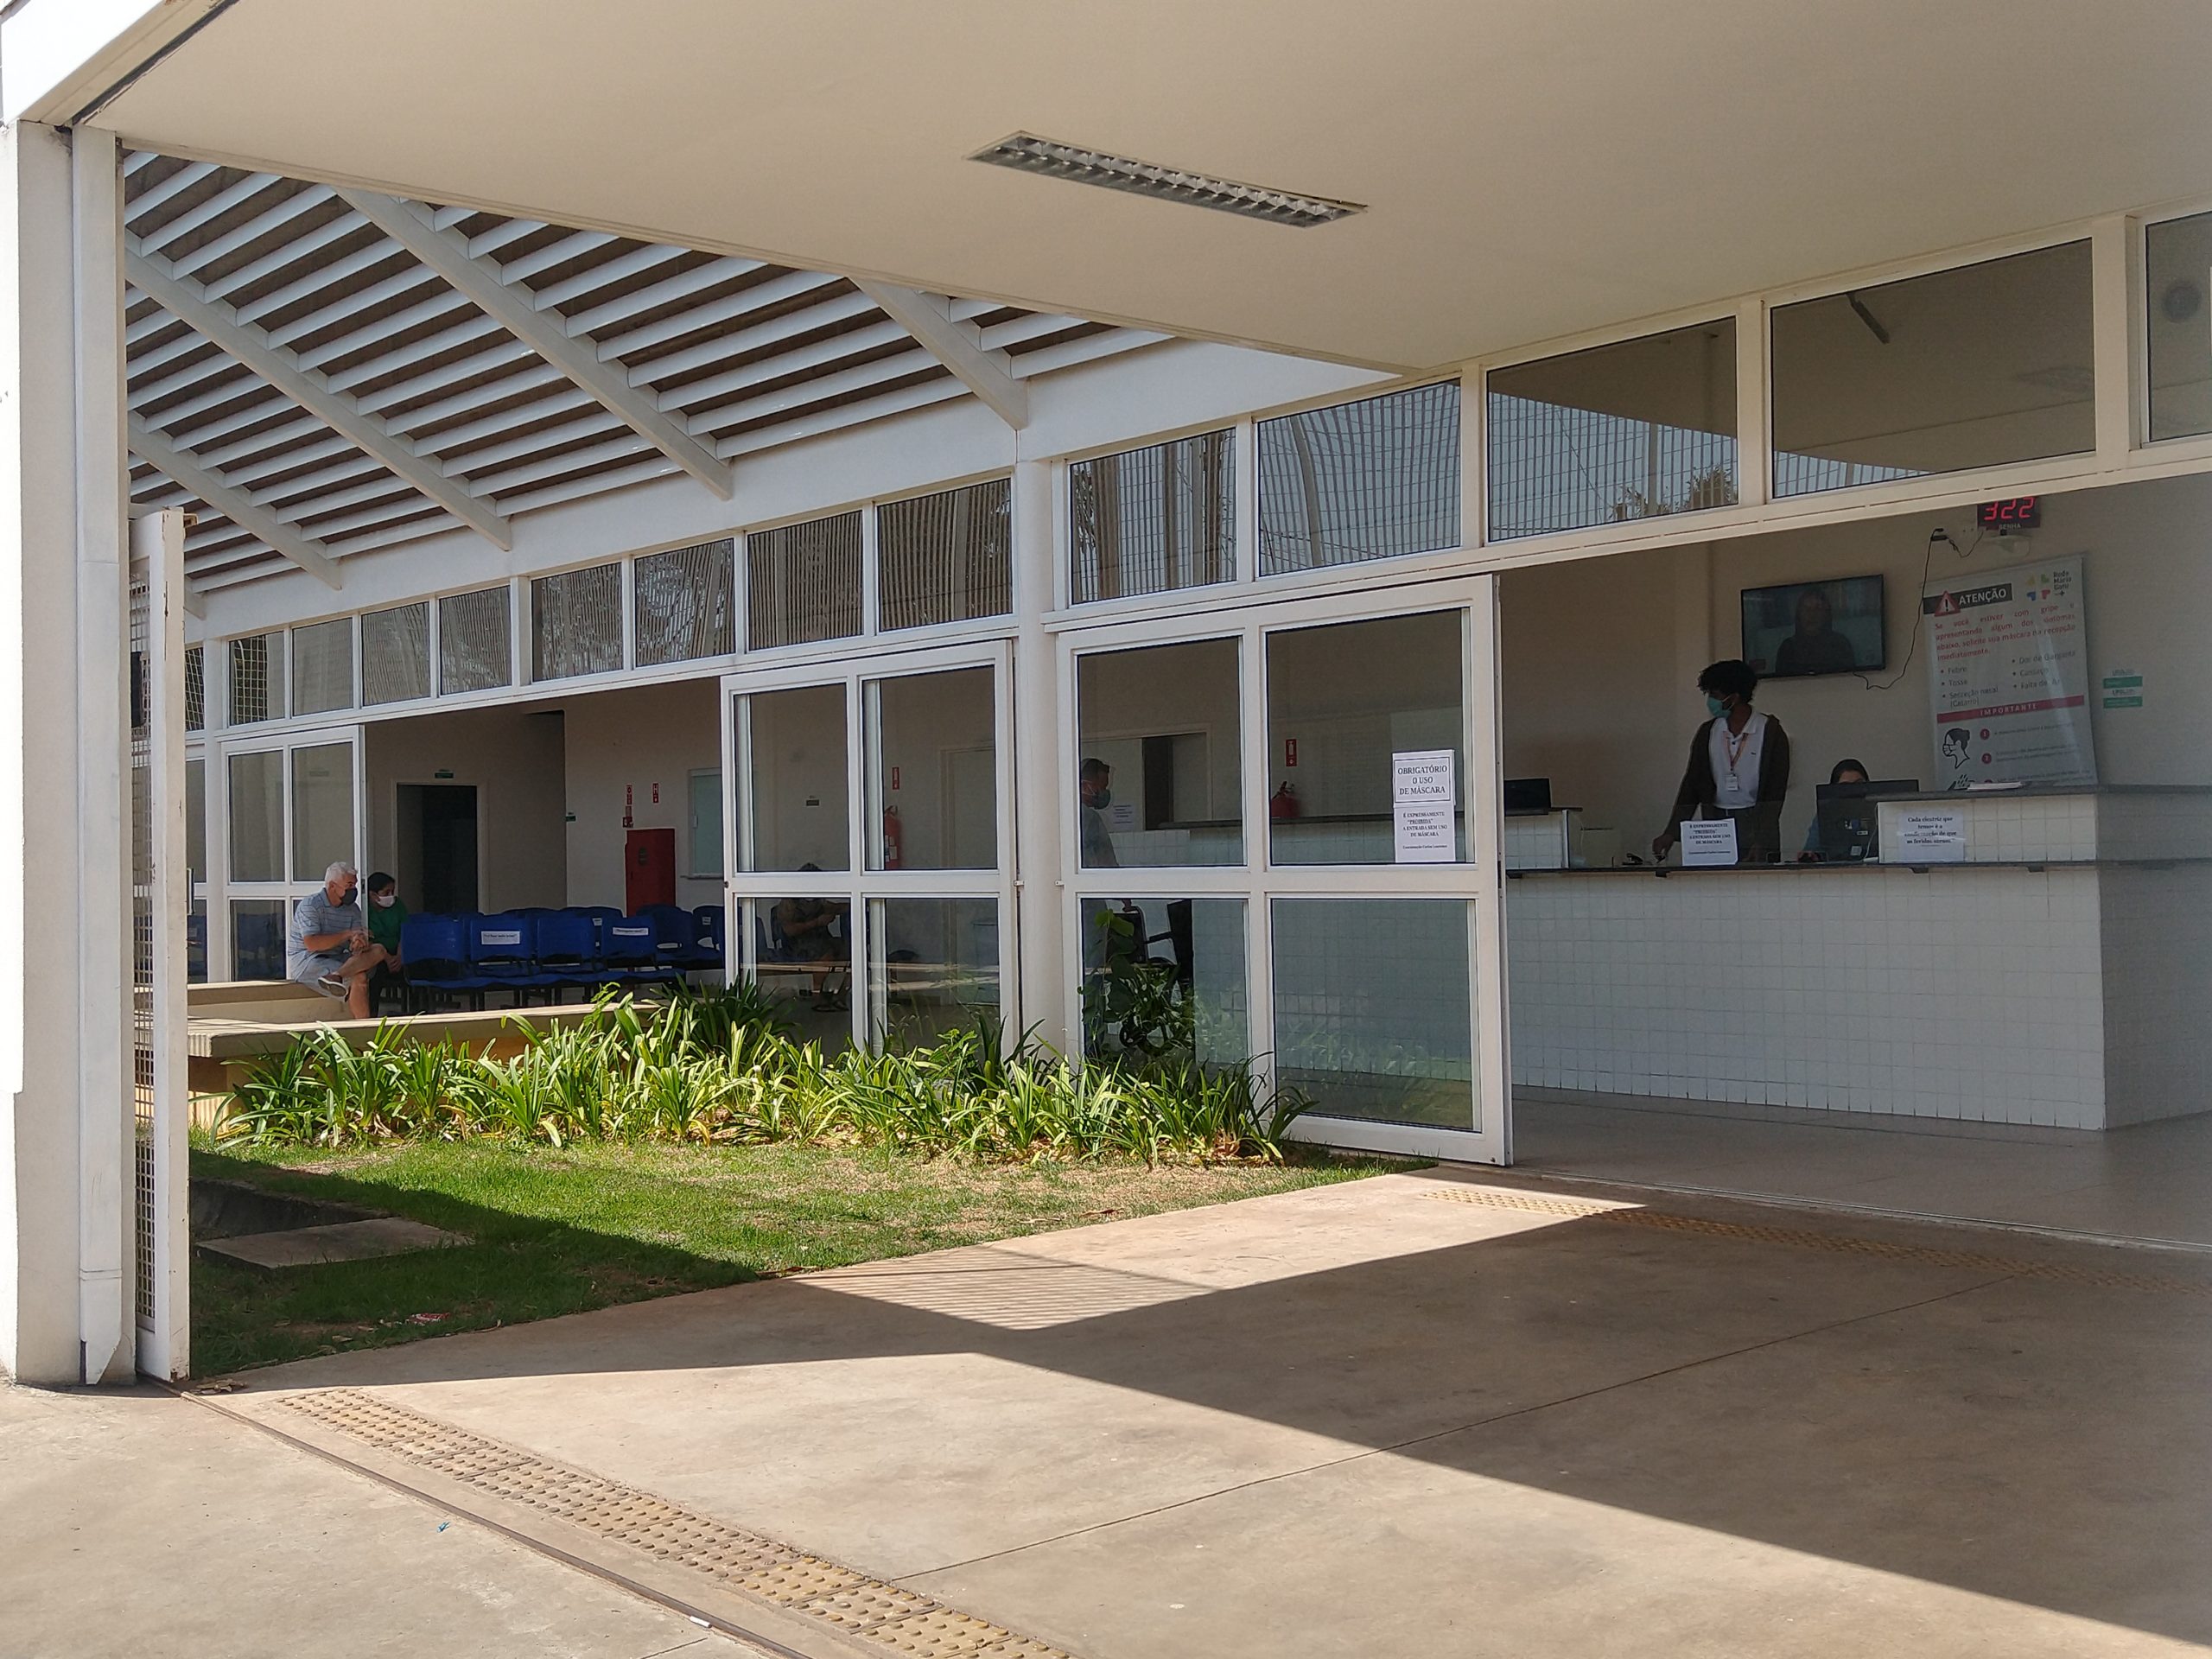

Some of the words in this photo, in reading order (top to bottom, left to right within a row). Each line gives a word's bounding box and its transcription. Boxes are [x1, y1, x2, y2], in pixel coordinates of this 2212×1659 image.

[1984, 495, 2035, 520] 322
[1959, 588, 2007, 606] ATENÇÃO
[1980, 613, 2004, 623] estiver
[2040, 605, 2059, 614] gripe
[1936, 627, 1983, 641] apresentando
[1980, 704, 2038, 716] IMPORTANTE
[1397, 765, 1447, 775] OBRIGATÓRIO
[1410, 785, 1446, 795] MÁSCARA
